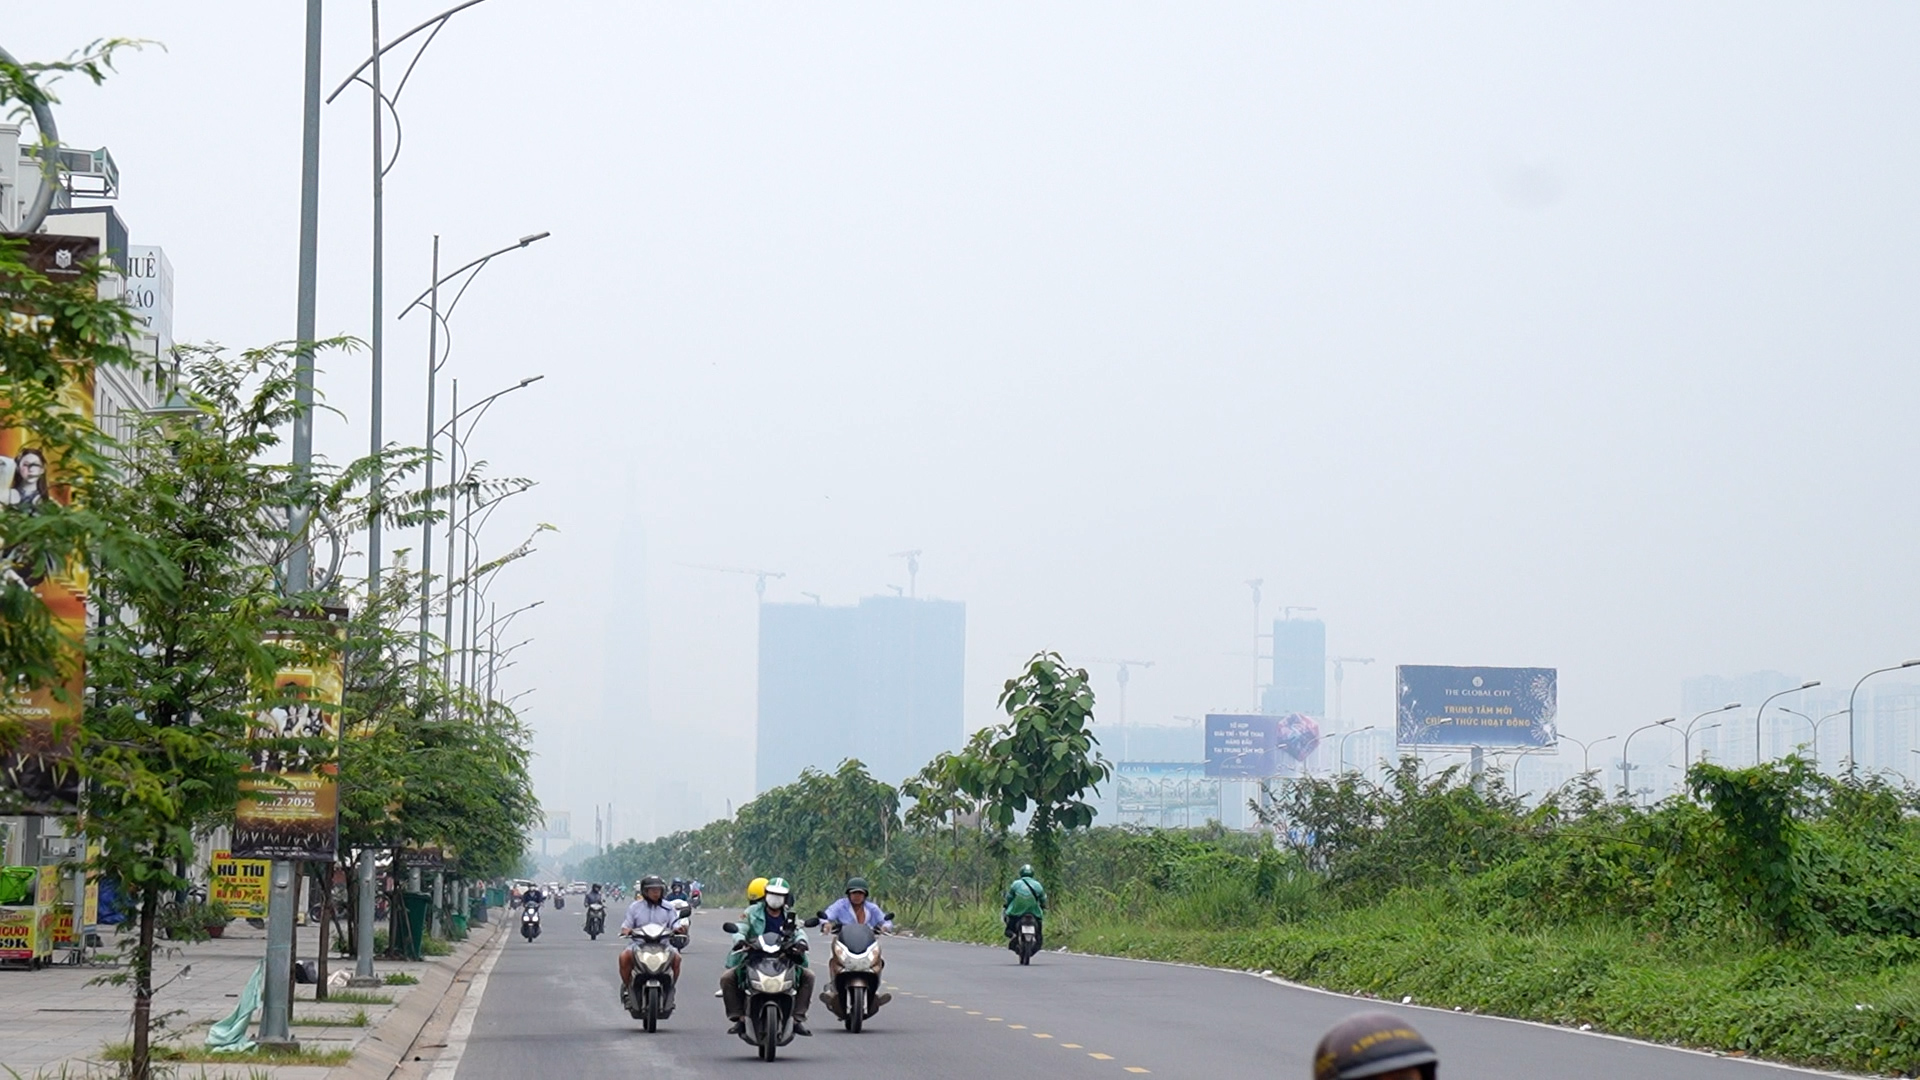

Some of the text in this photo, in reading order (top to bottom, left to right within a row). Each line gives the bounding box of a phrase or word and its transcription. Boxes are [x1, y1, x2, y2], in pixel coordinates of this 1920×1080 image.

[1461, 689, 1491, 697] GLOBAL
[1493, 689, 1512, 697] CITY
[1444, 704, 1513, 715] TRUNG TÂM MỚI
[1425, 716, 1531, 728] CHÍ THỨC HOẠT ĐỘNG
[303, 779, 323, 789] CITY
[217, 861, 265, 878] HỦ TÍU
